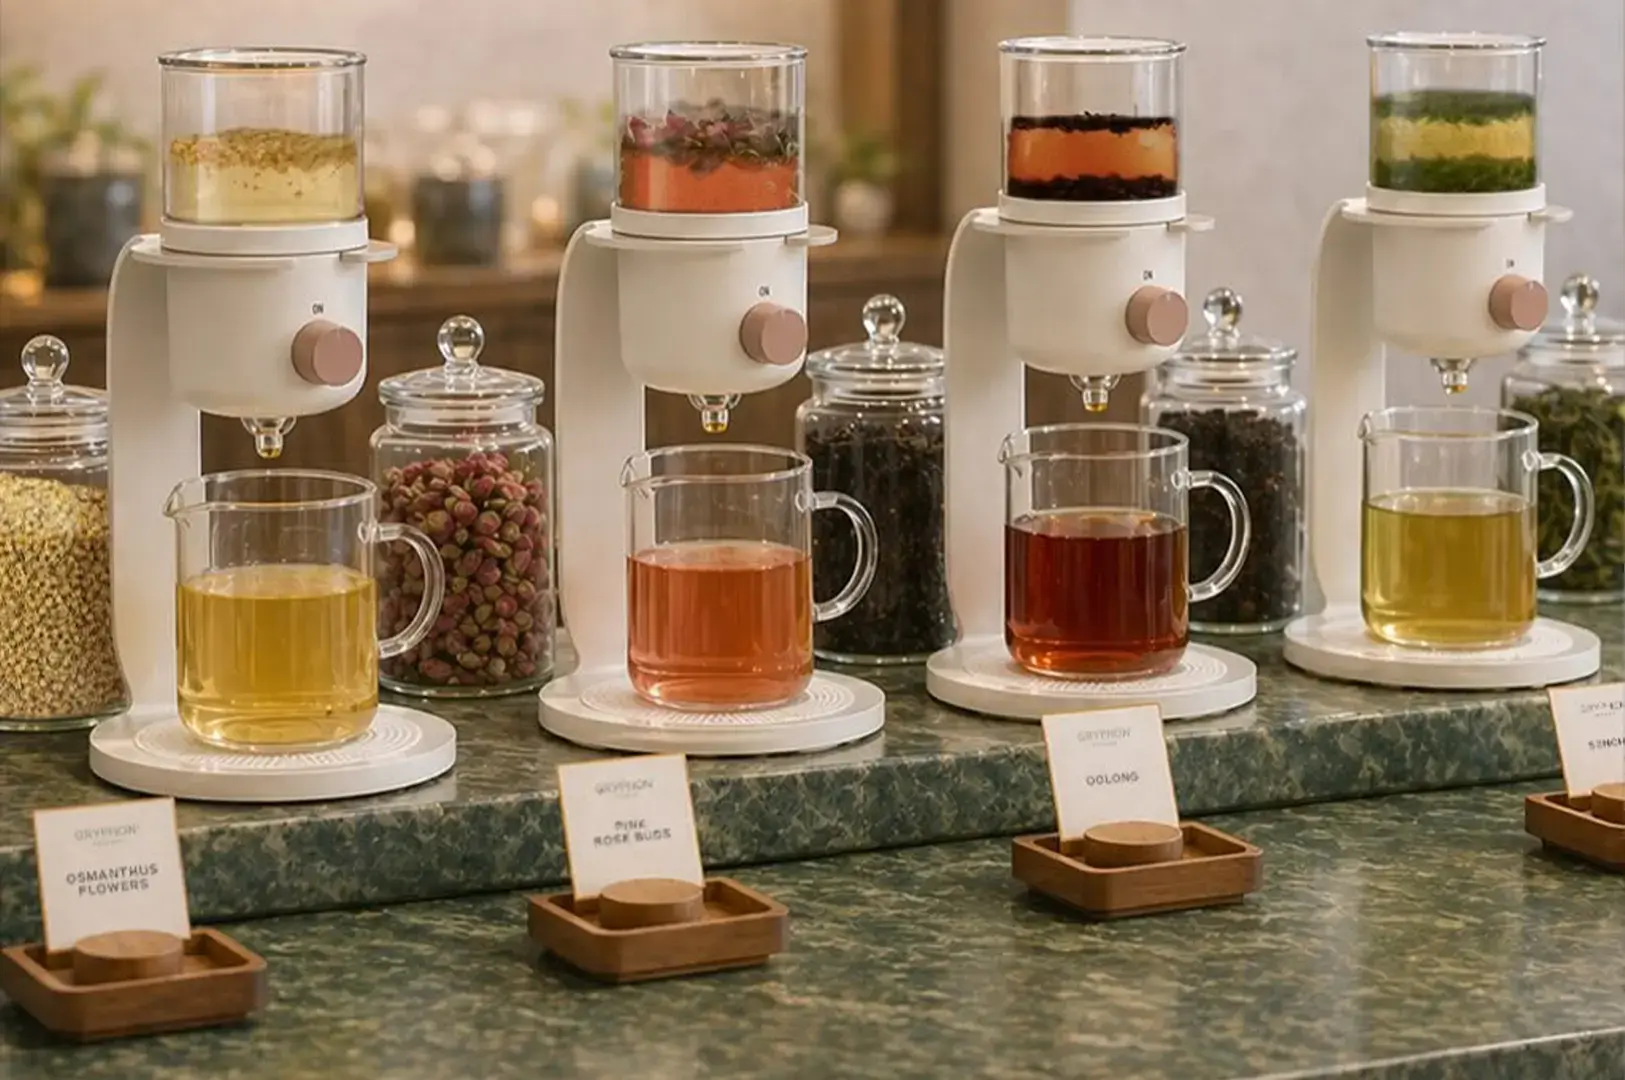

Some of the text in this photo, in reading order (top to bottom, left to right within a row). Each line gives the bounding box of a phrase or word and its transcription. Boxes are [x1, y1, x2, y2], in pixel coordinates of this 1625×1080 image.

[1086, 771, 1139, 787] OOLONG
[66, 862, 159, 885] OSMANTHUS
[78, 878, 150, 898] FLOWERS
